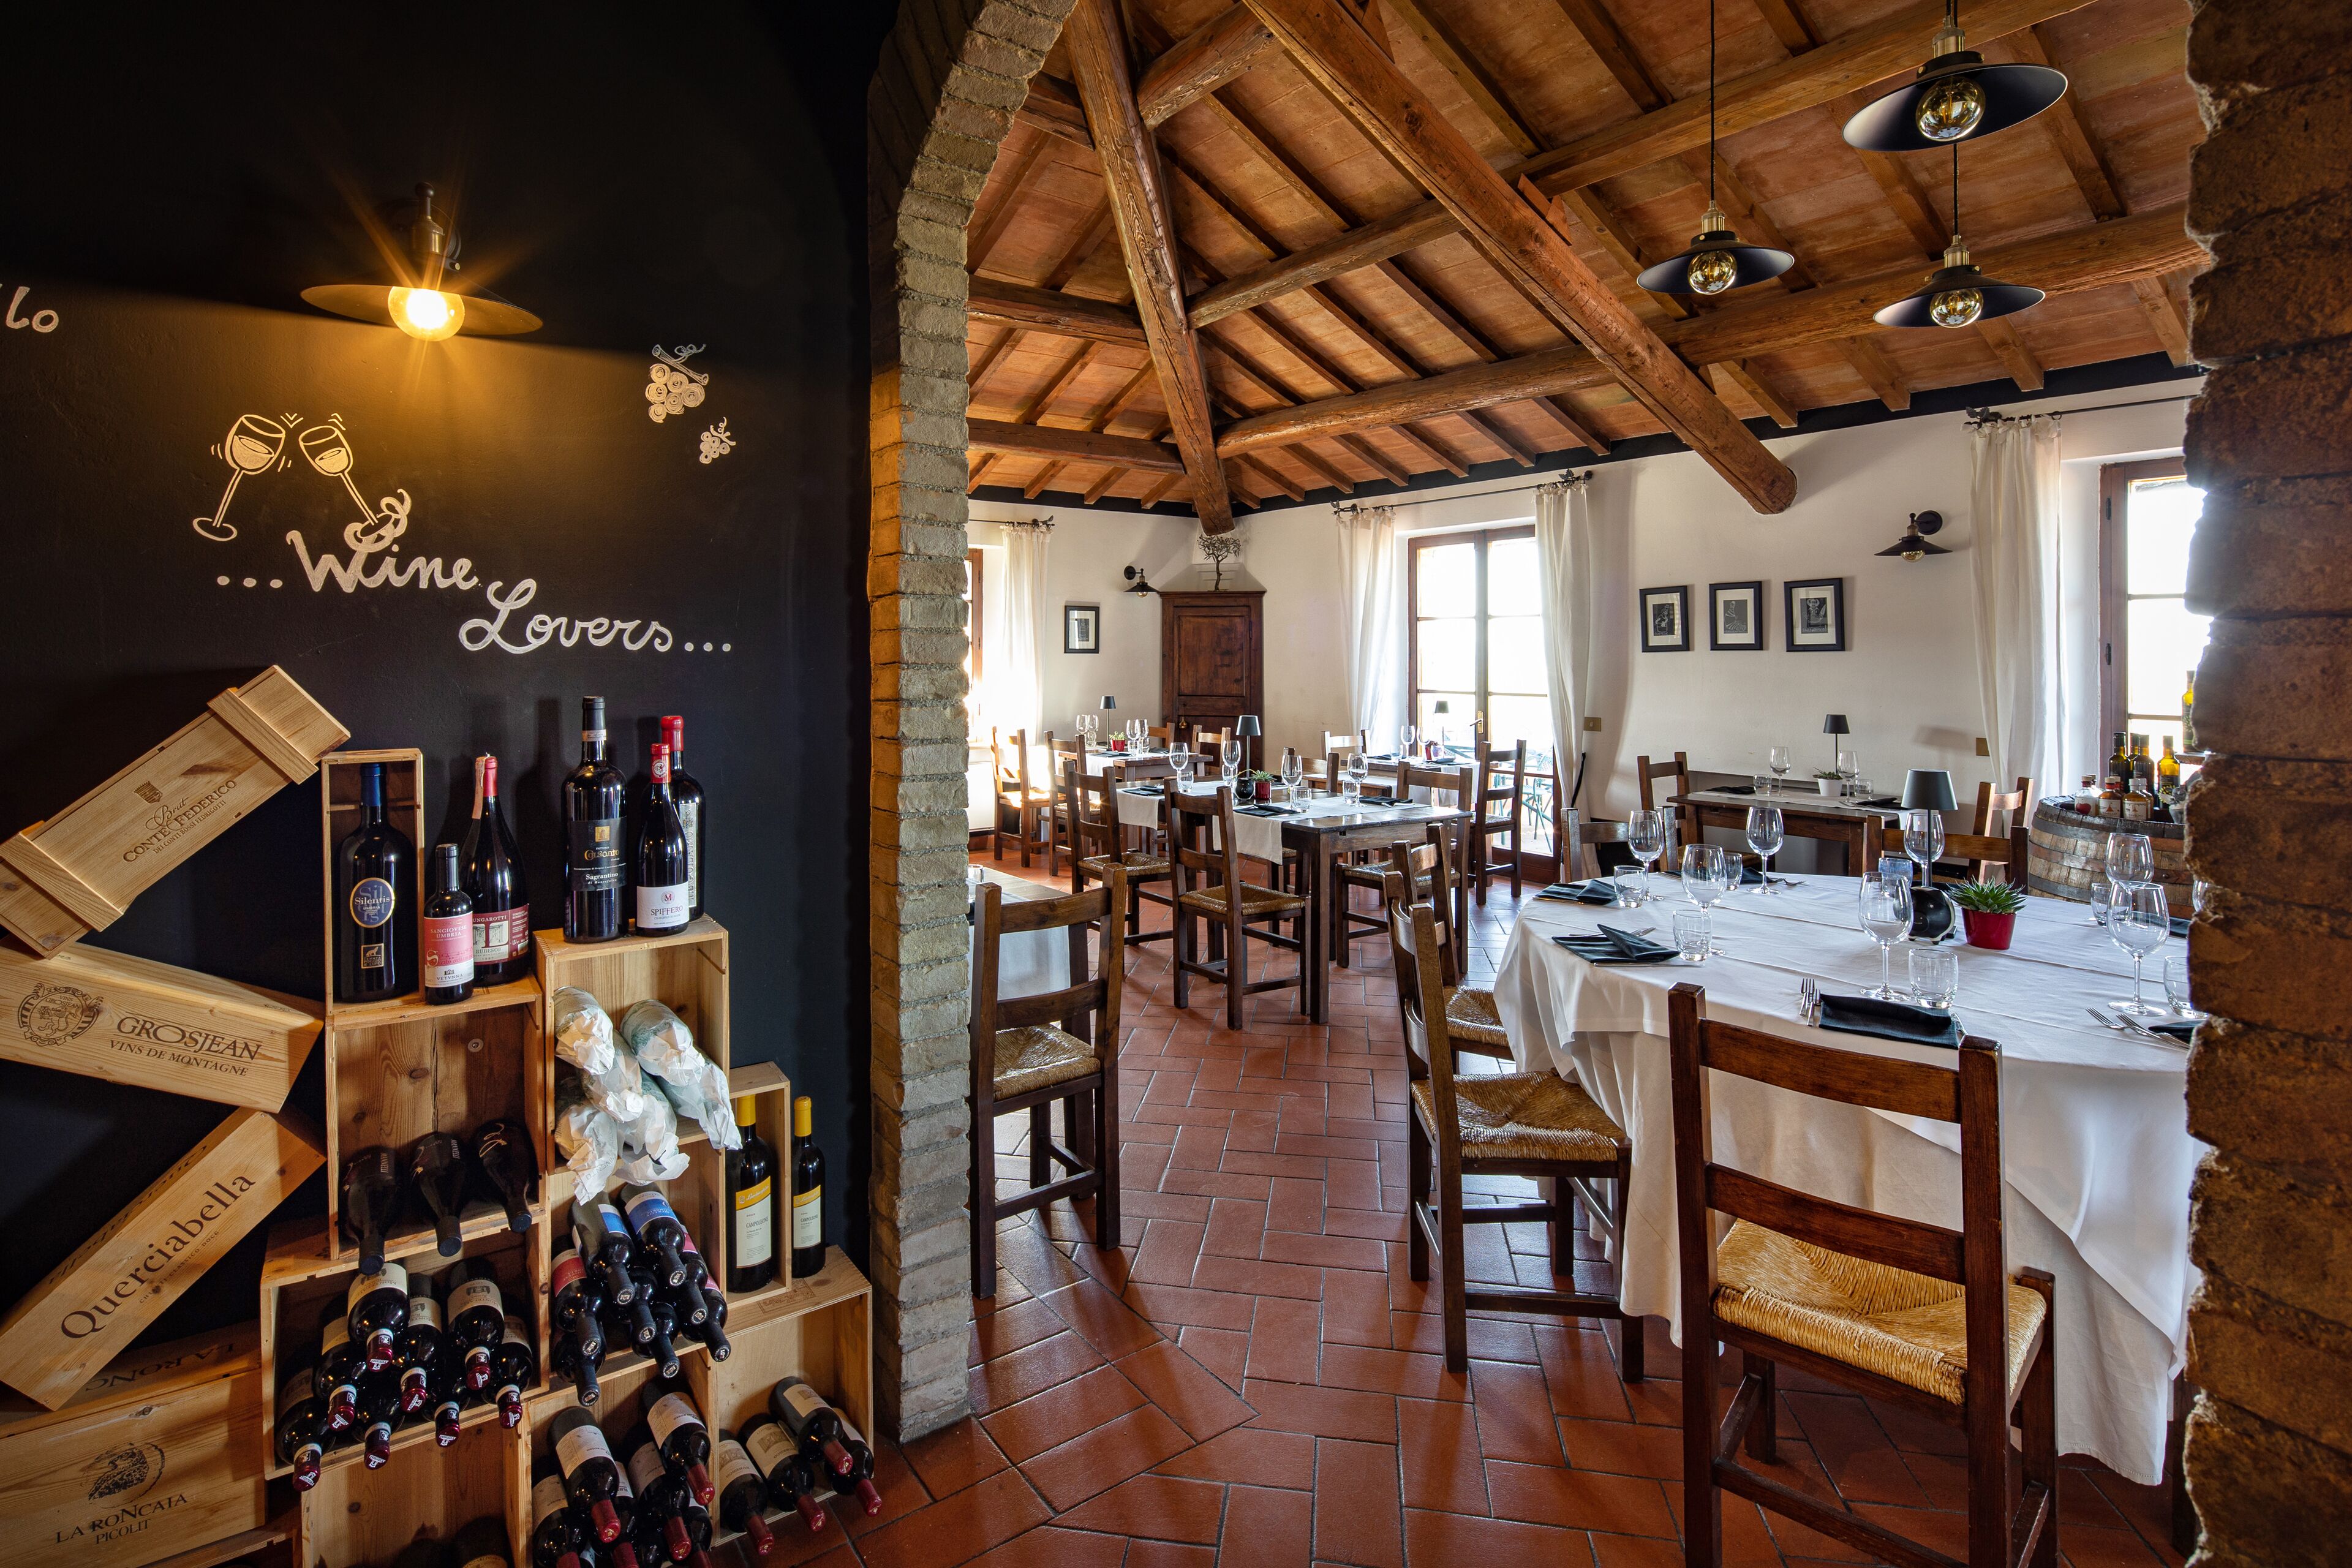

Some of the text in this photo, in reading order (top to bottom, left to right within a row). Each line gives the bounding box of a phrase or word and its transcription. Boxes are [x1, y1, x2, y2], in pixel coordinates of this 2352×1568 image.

[0, 284, 59, 333] lo
[123, 779, 237, 862] CONTE FEDERICO
[145, 797, 189, 831] Brut
[153, 844, 164, 854] DEI
[163, 833, 181, 846] CONTI
[586, 872, 619, 881] Sagrantino
[355, 895, 390, 905] Silentis
[650, 905, 684, 916] SPIFFERO
[431, 924, 467, 933] SANGIOVESE
[45, 997, 81, 1009] GROSJEAN
[116, 1016, 262, 1061] GROSJEAN
[110, 1039, 249, 1076] VINS DE MONTAGNE
[746, 1216, 769, 1229] CAMPOLEONE
[800, 1214, 818, 1223] CAMPOLEONE
[61, 1175, 256, 1339] Querciabella
[168, 1248, 200, 1277] CLASSICO
[200, 1230, 220, 1248] DOCG
[85, 1357, 183, 1392] RONC
[56, 1493, 189, 1544] LA RONCAIA
[96, 1518, 152, 1545] PICOLIT
